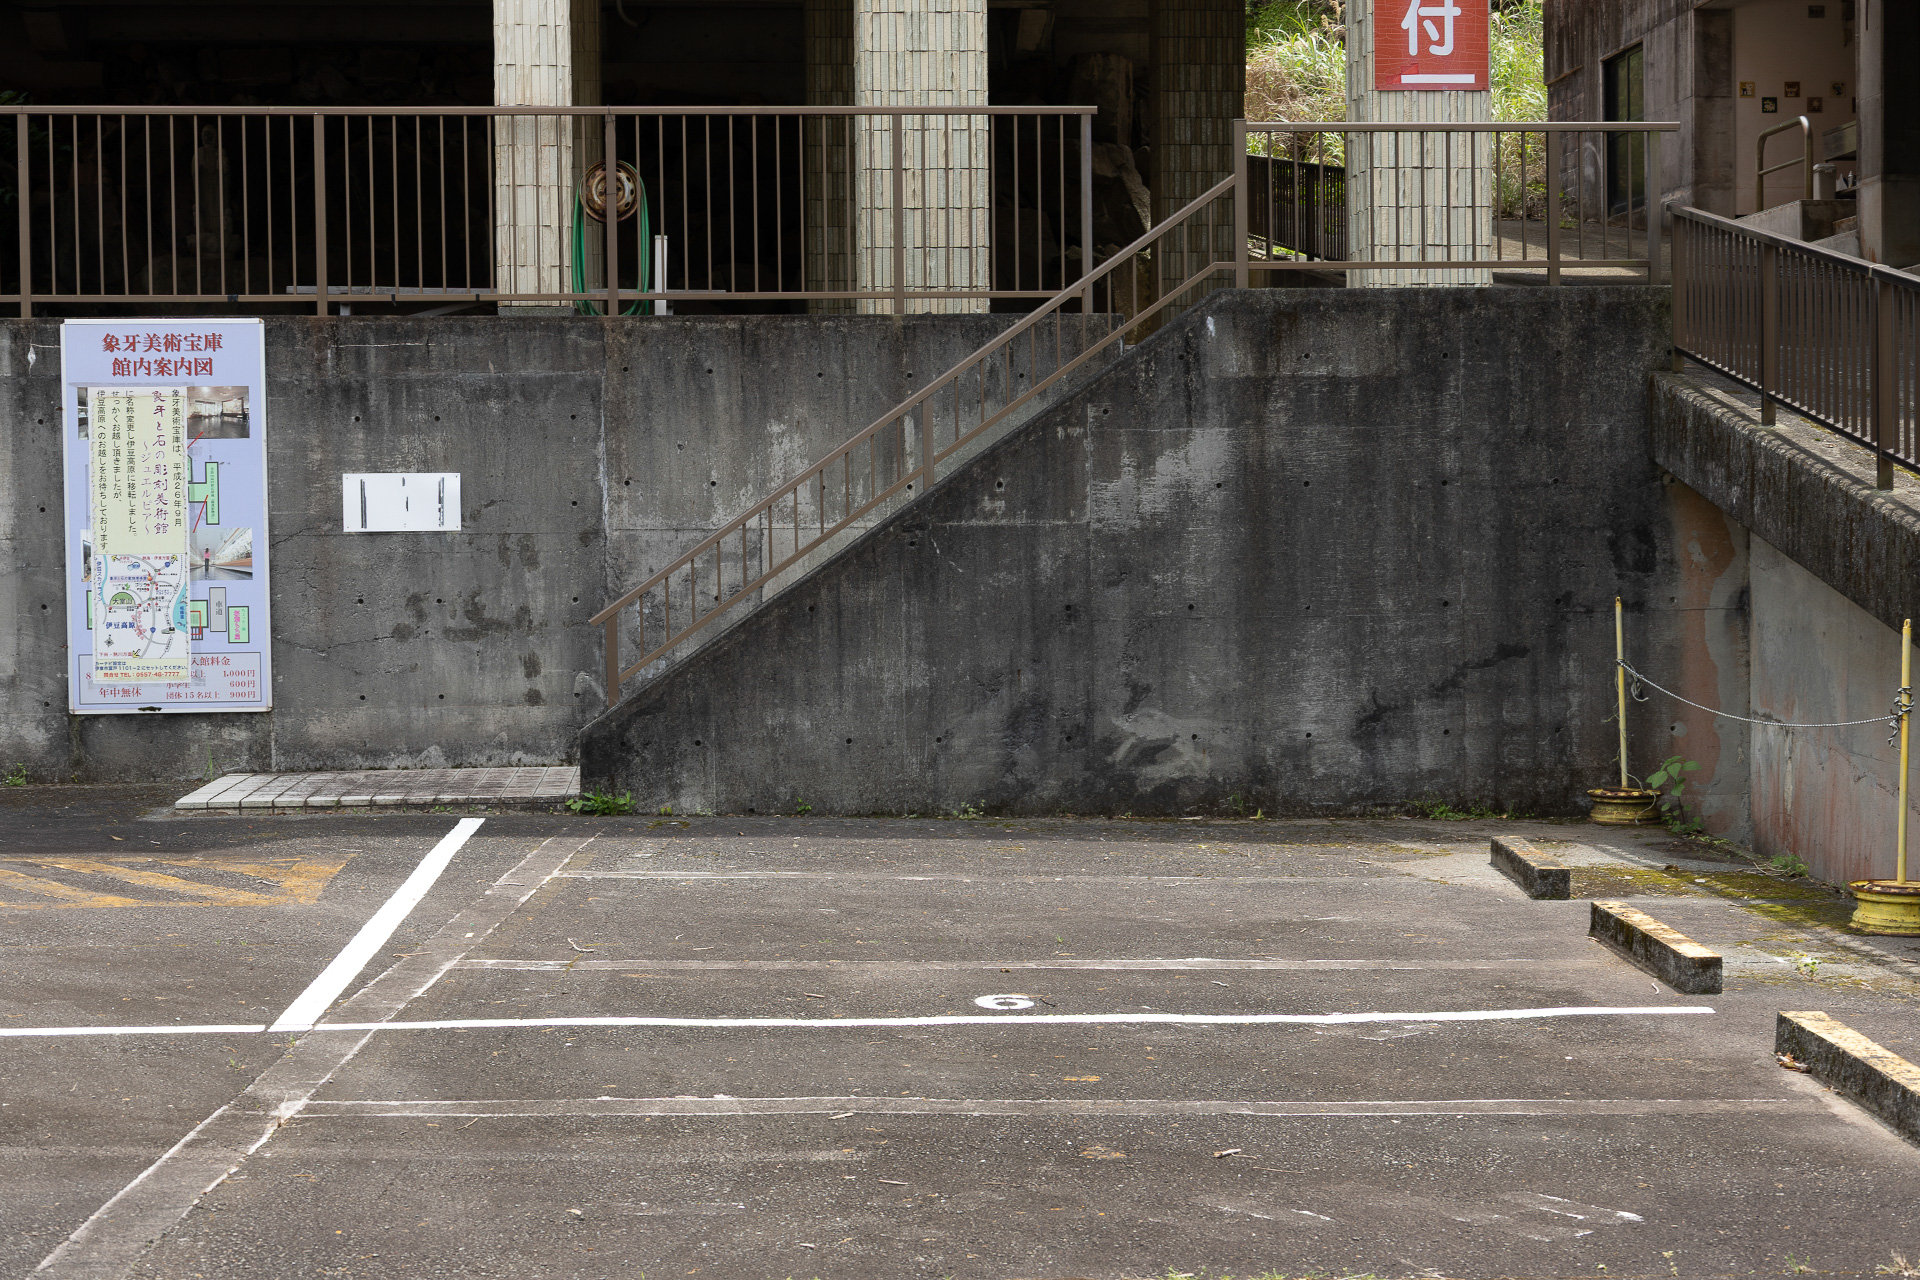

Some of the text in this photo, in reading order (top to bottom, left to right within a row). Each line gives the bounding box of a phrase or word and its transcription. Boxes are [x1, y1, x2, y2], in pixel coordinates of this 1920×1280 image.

[1401, 0, 1461, 56] 付
[102, 333, 223, 353] 象牙美術宝庫
[111, 357, 213, 377] 館内案内図
[152, 390, 169, 534] 象牙と石の彫刻美術館
[191, 656, 230, 666] 入館料金
[229, 680, 255, 688] 600円
[99, 687, 142, 698] 年中無休
[229, 691, 256, 699] 900円
